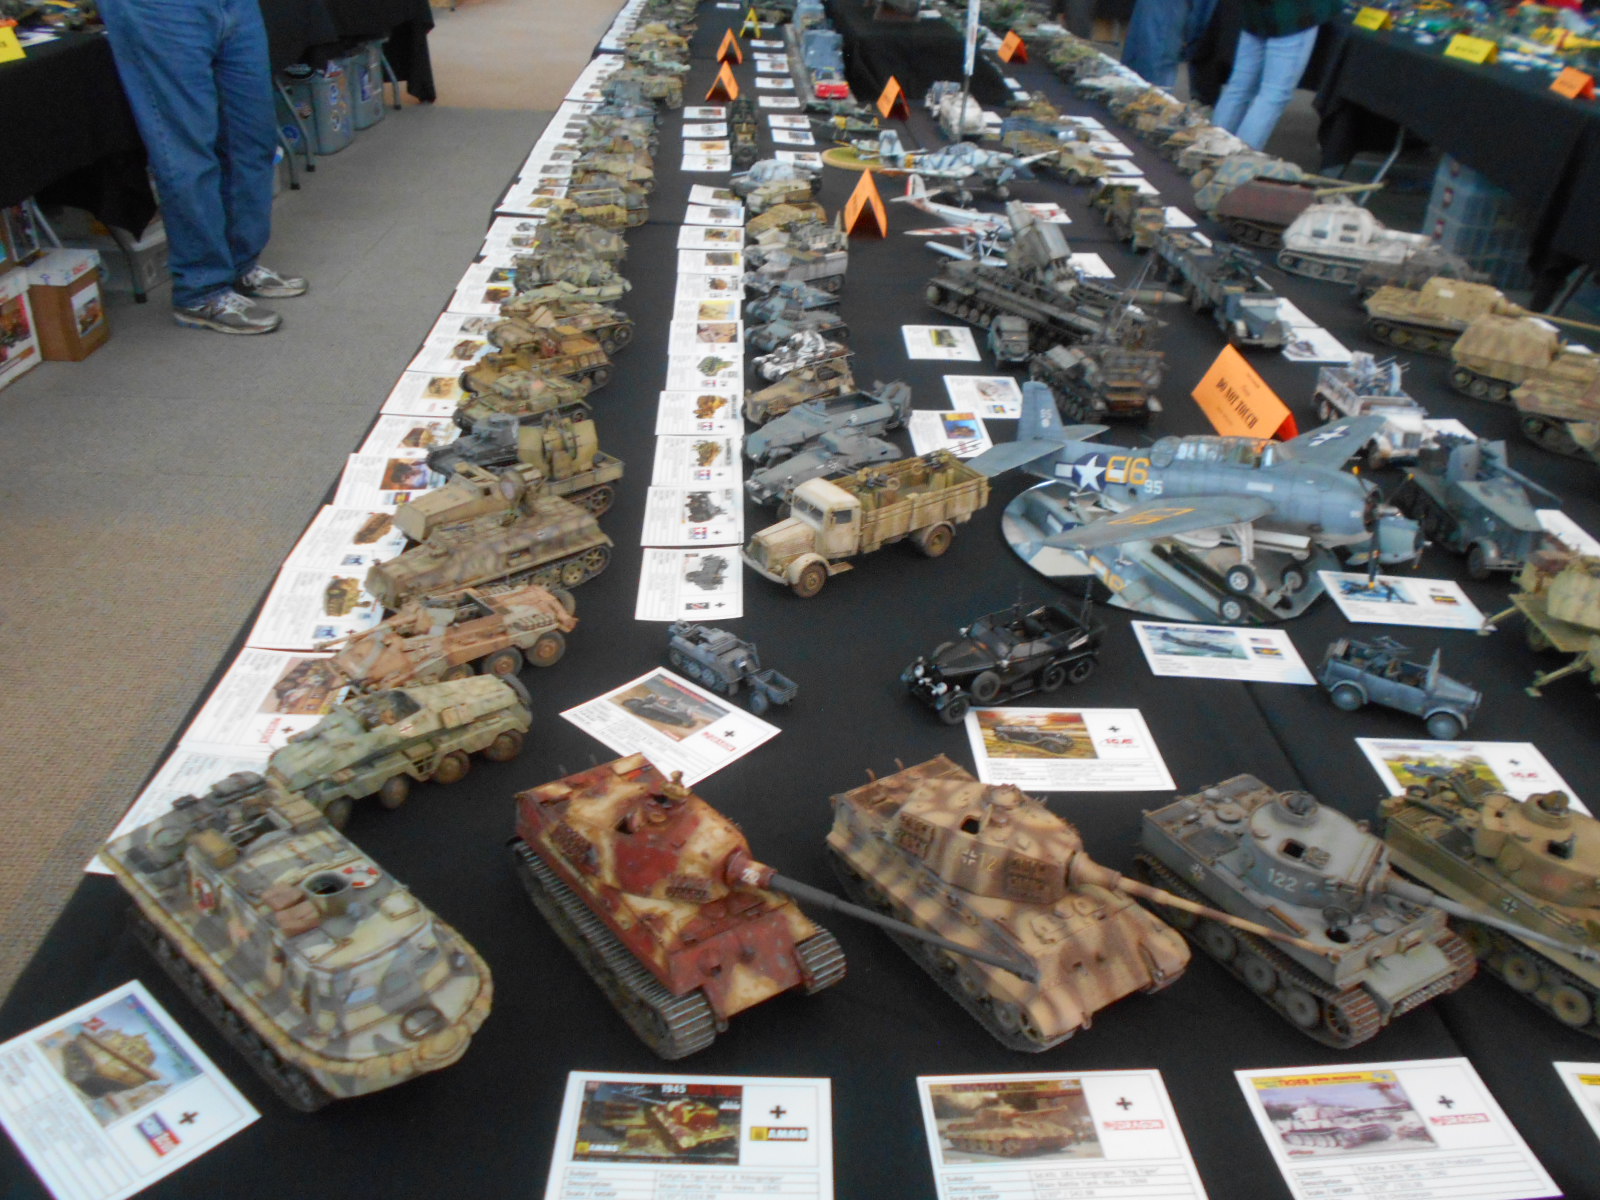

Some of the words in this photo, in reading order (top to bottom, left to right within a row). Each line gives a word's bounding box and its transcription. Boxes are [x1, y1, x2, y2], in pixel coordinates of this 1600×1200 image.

[1215, 377, 1228, 392] DO
[1224, 386, 1240, 406] NOT
[1234, 400, 1259, 430] TOUCH
[1267, 867, 1298, 892] 122
